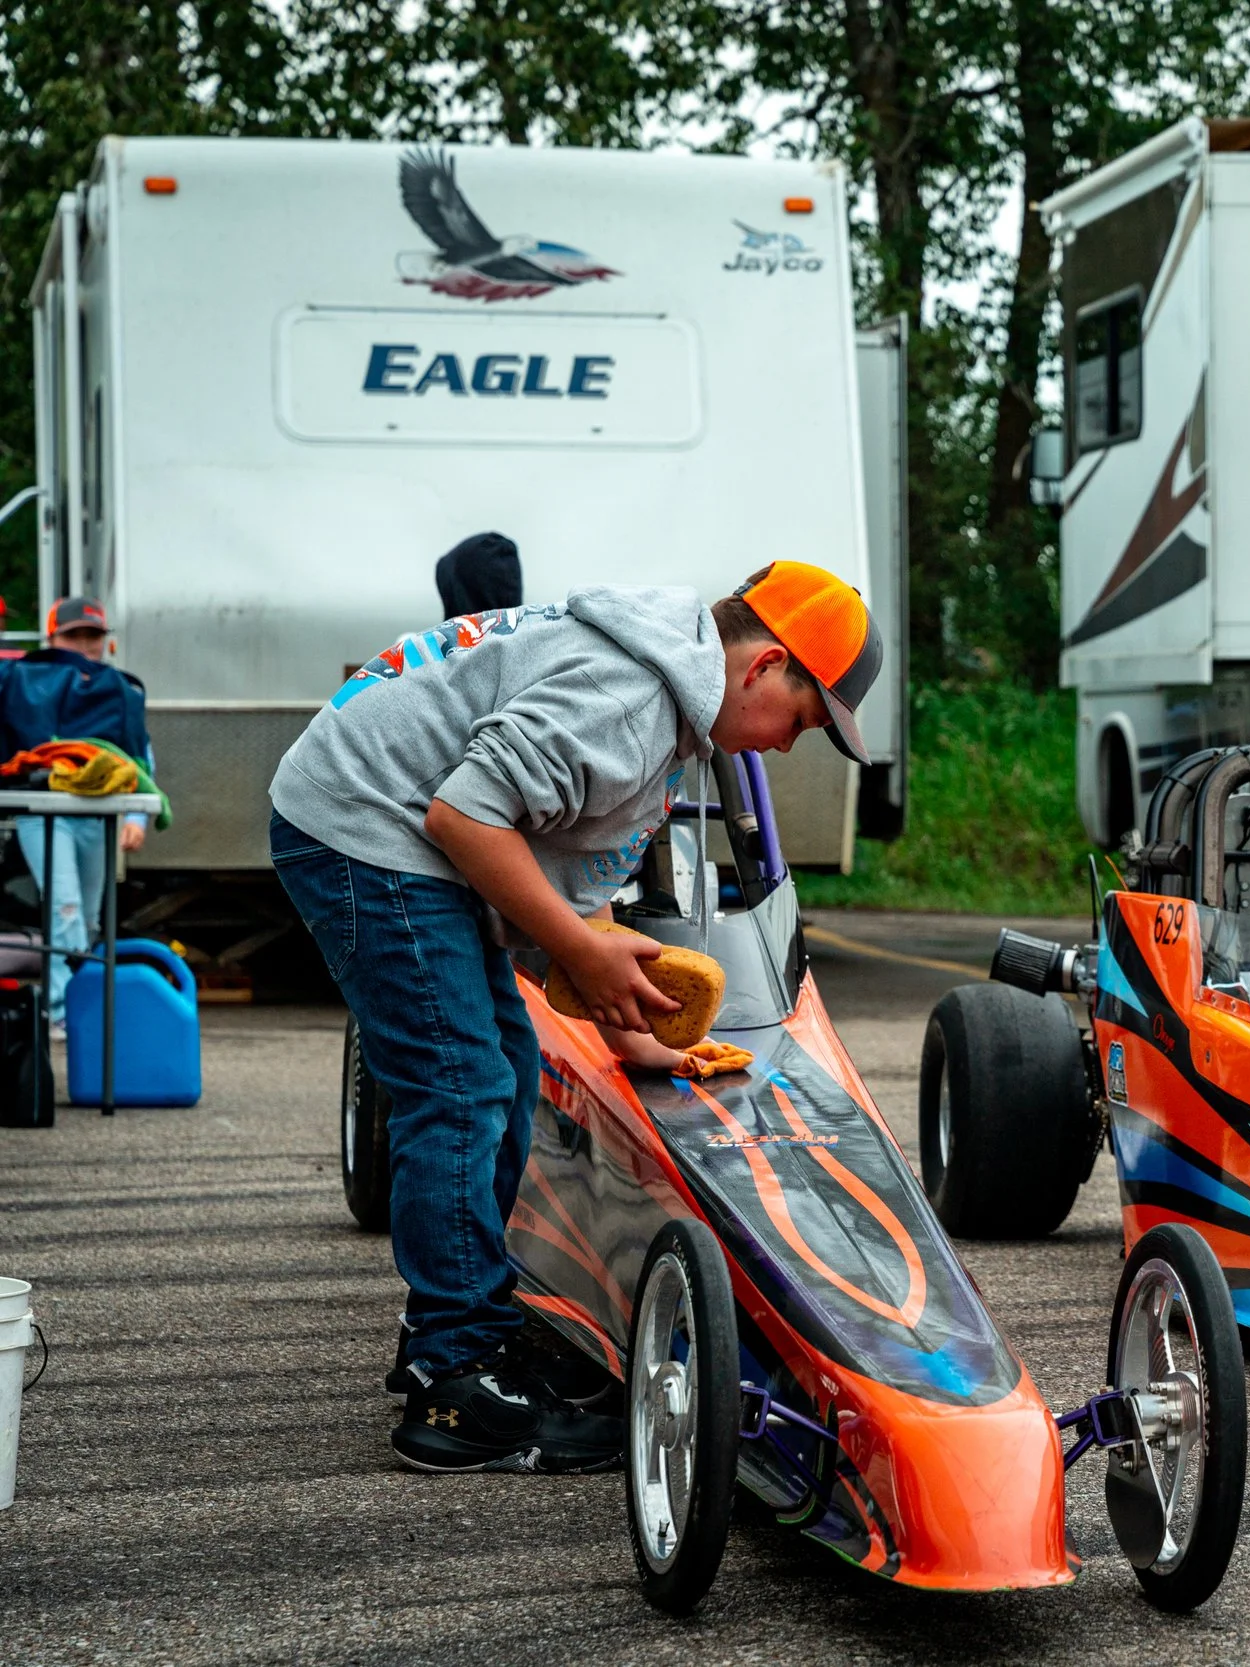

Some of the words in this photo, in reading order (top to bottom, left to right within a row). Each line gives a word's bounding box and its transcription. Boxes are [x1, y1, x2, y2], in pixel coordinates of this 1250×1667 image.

[722, 252, 823, 276] Jayco
[363, 343, 617, 399] EAGLE
[1153, 903, 1185, 945] 629
